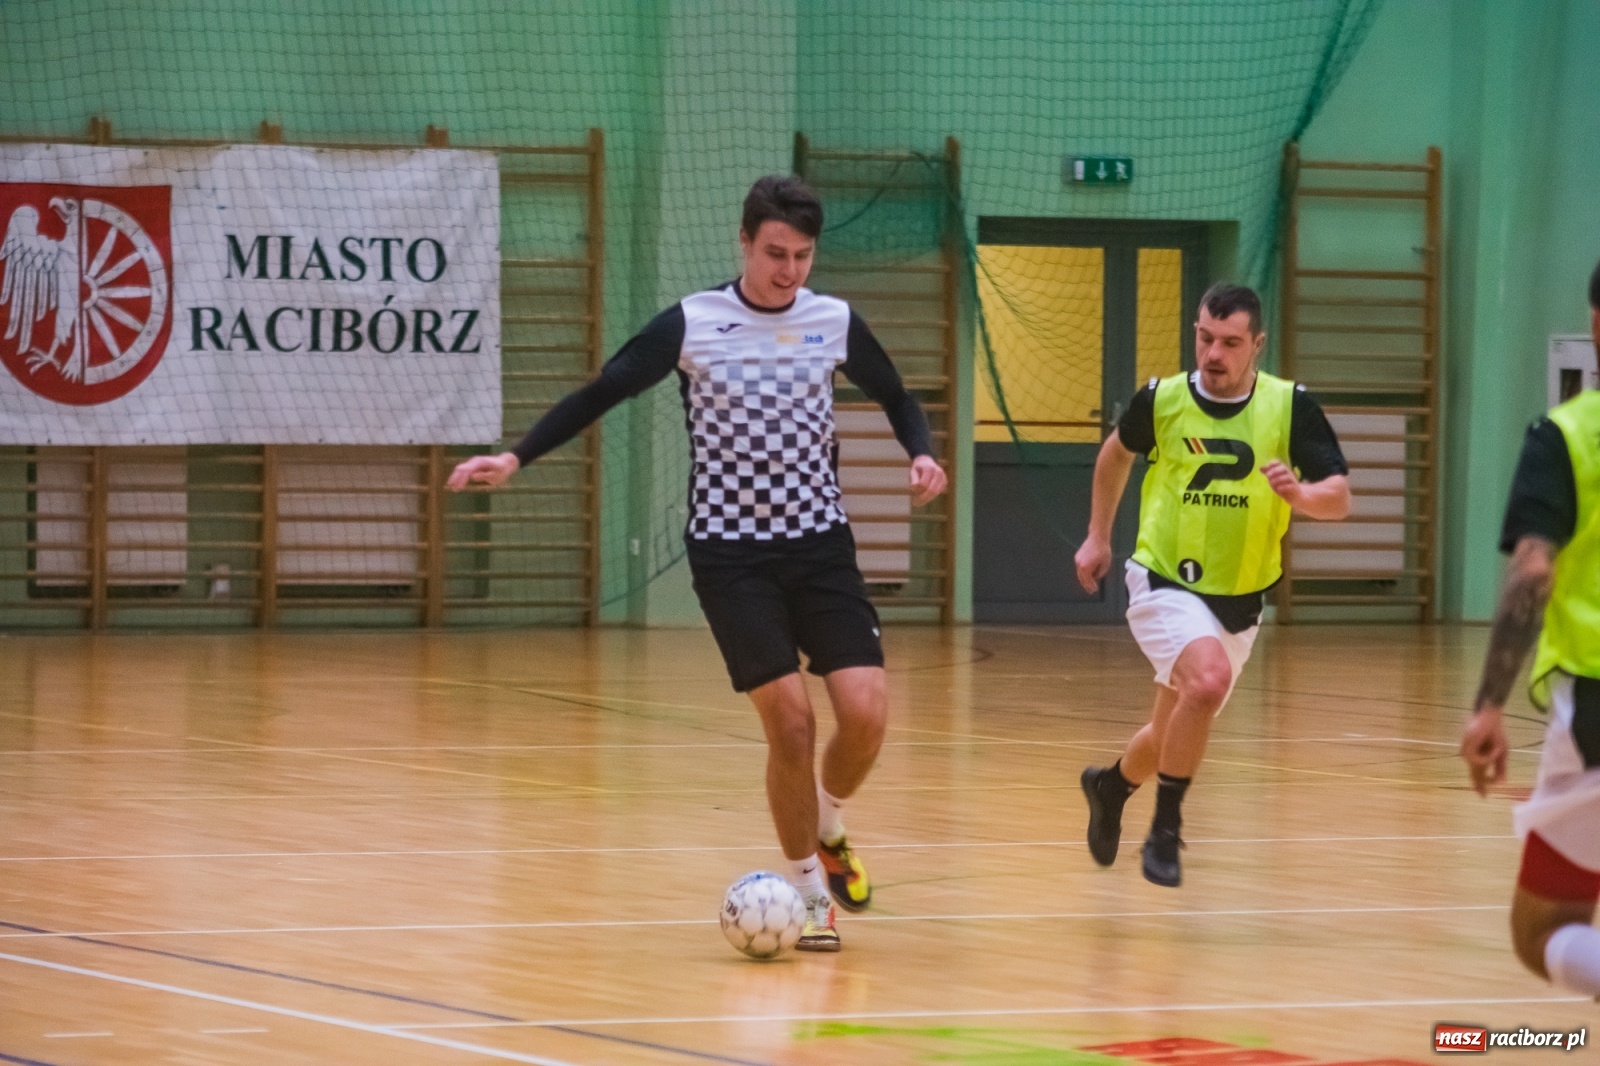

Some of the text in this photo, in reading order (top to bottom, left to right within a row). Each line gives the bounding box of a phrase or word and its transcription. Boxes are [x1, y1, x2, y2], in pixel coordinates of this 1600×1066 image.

[224, 234, 447, 283] MIASTO
[188, 295, 481, 353] RACIBÓRZ
[1183, 492, 1249, 508] PATRICK
[1183, 561, 1195, 583] 1
